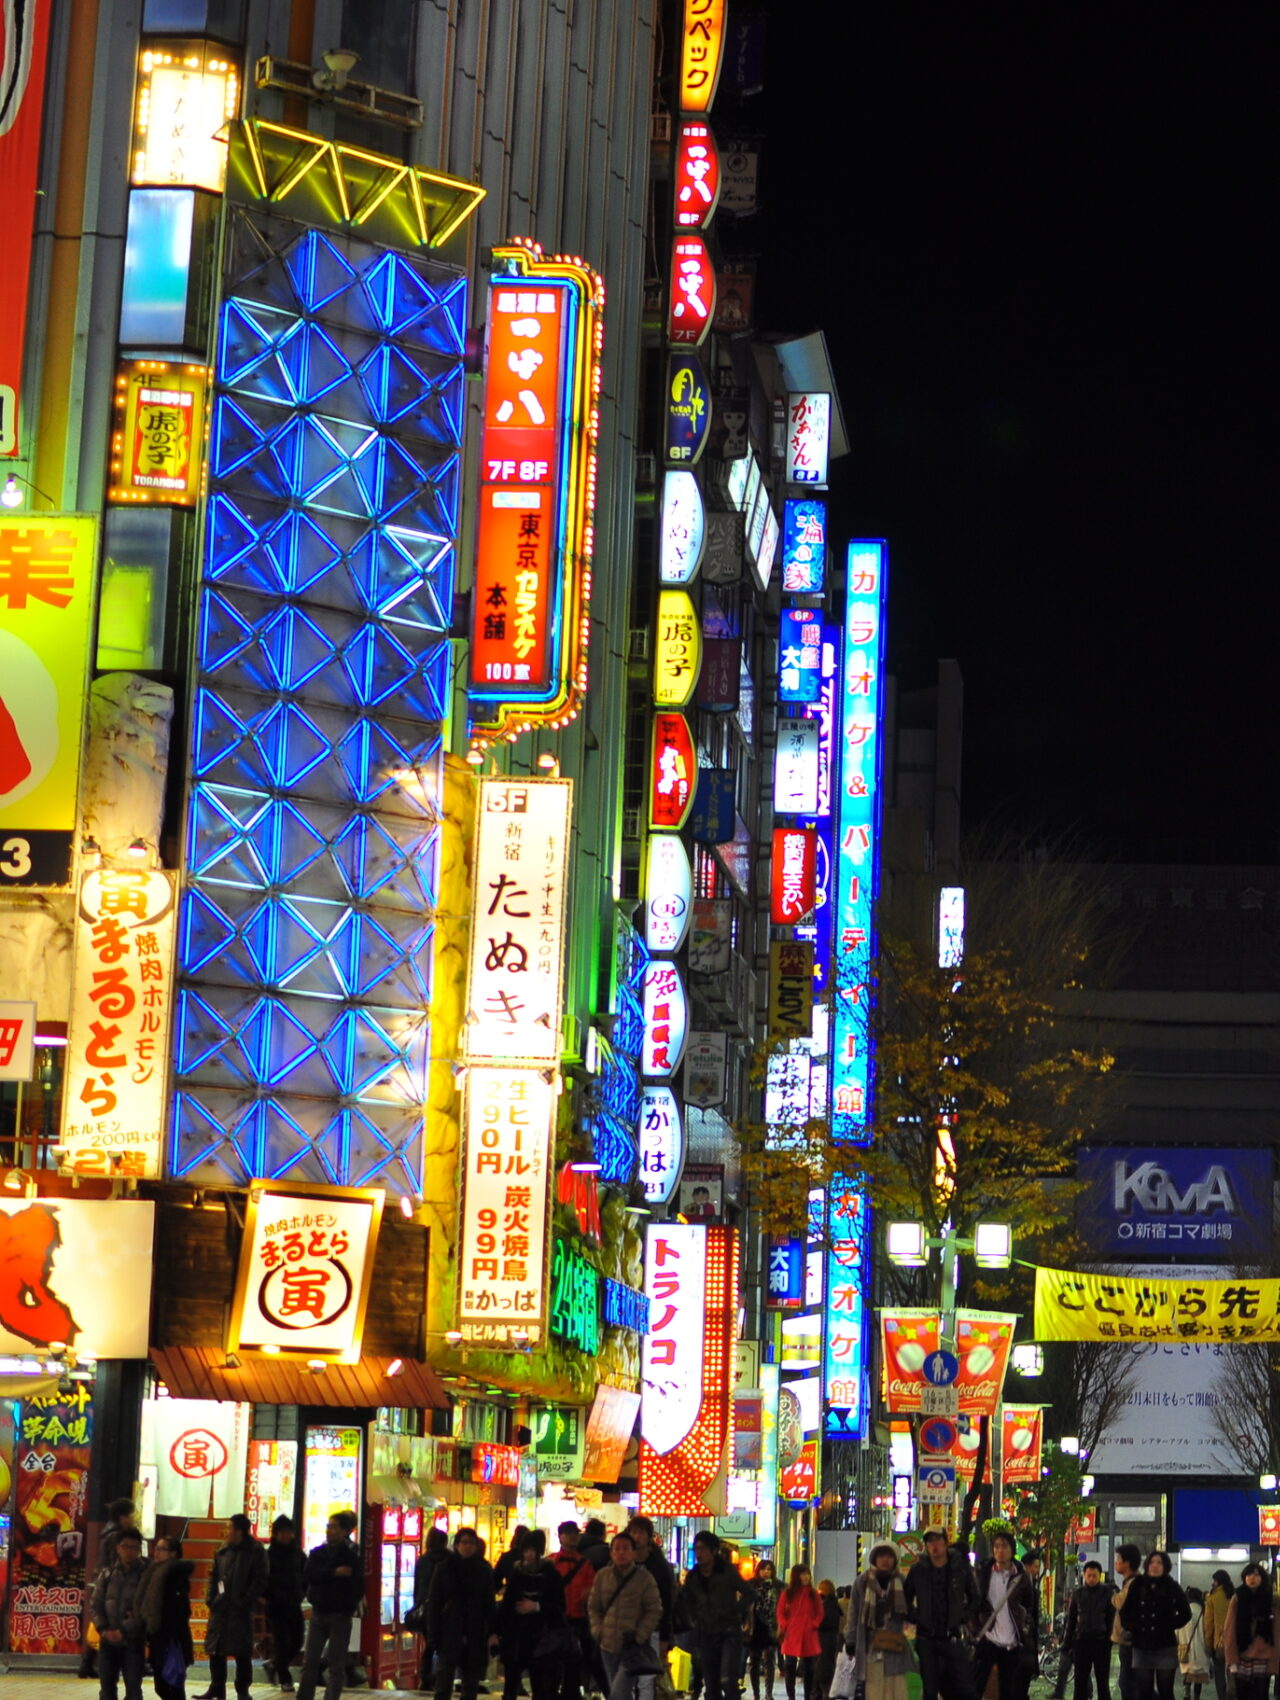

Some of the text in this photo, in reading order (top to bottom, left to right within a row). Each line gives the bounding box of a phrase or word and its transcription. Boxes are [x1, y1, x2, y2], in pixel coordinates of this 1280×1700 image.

[488, 461, 549, 481] 7F 8F
[487, 788, 527, 813] 5F
[80, 918, 136, 1118] まるとら
[132, 931, 164, 1085] 焼肉ホルモン
[504, 1079, 532, 1177] 生ビール
[260, 1230, 350, 1268] まるとら
[471, 1208, 499, 1282] 99円
[501, 1185, 532, 1284] 炭火焼鳥
[1135, 1222, 1233, 1241] 新宿コマ劇場
[279, 1266, 331, 1321] 寅
[651, 1238, 681, 1365] トラノコ
[769, 1247, 791, 1294] 大和
[829, 1192, 860, 1406] カラオケ館
